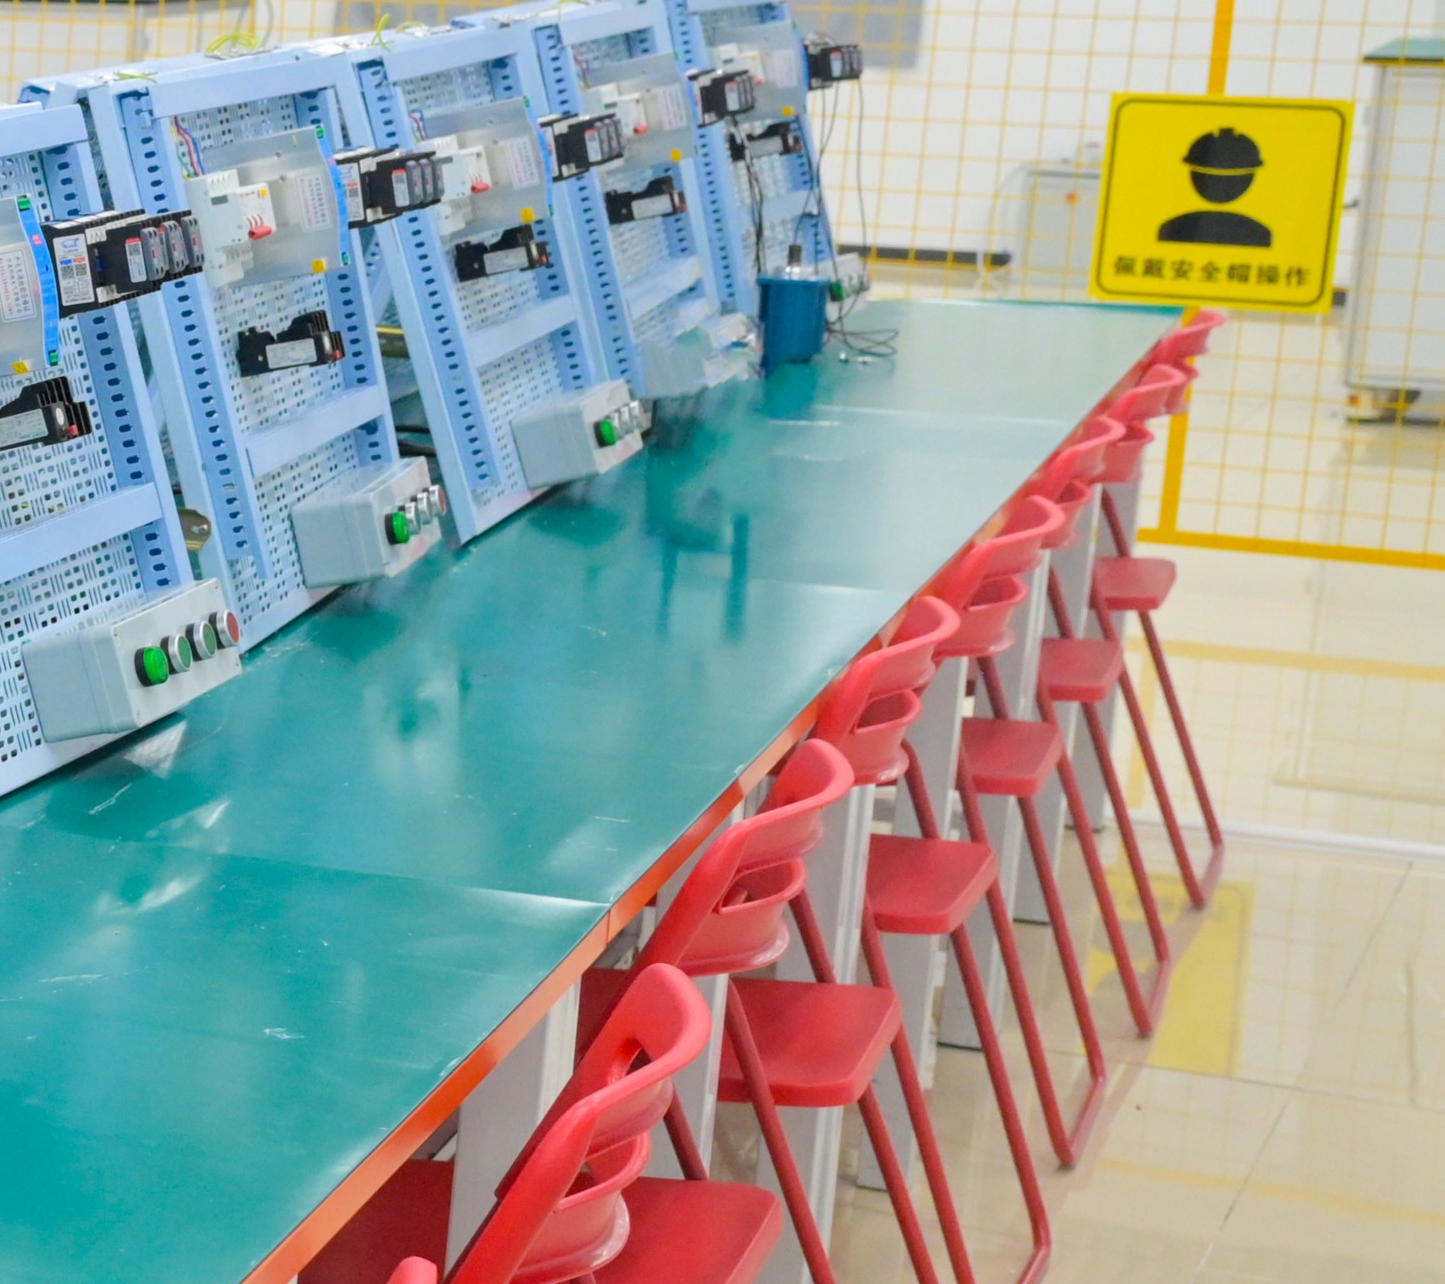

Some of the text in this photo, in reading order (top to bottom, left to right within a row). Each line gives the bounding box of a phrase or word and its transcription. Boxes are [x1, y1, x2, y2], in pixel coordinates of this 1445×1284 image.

[1114, 255, 1310, 288] 佩戴安全帽操作
